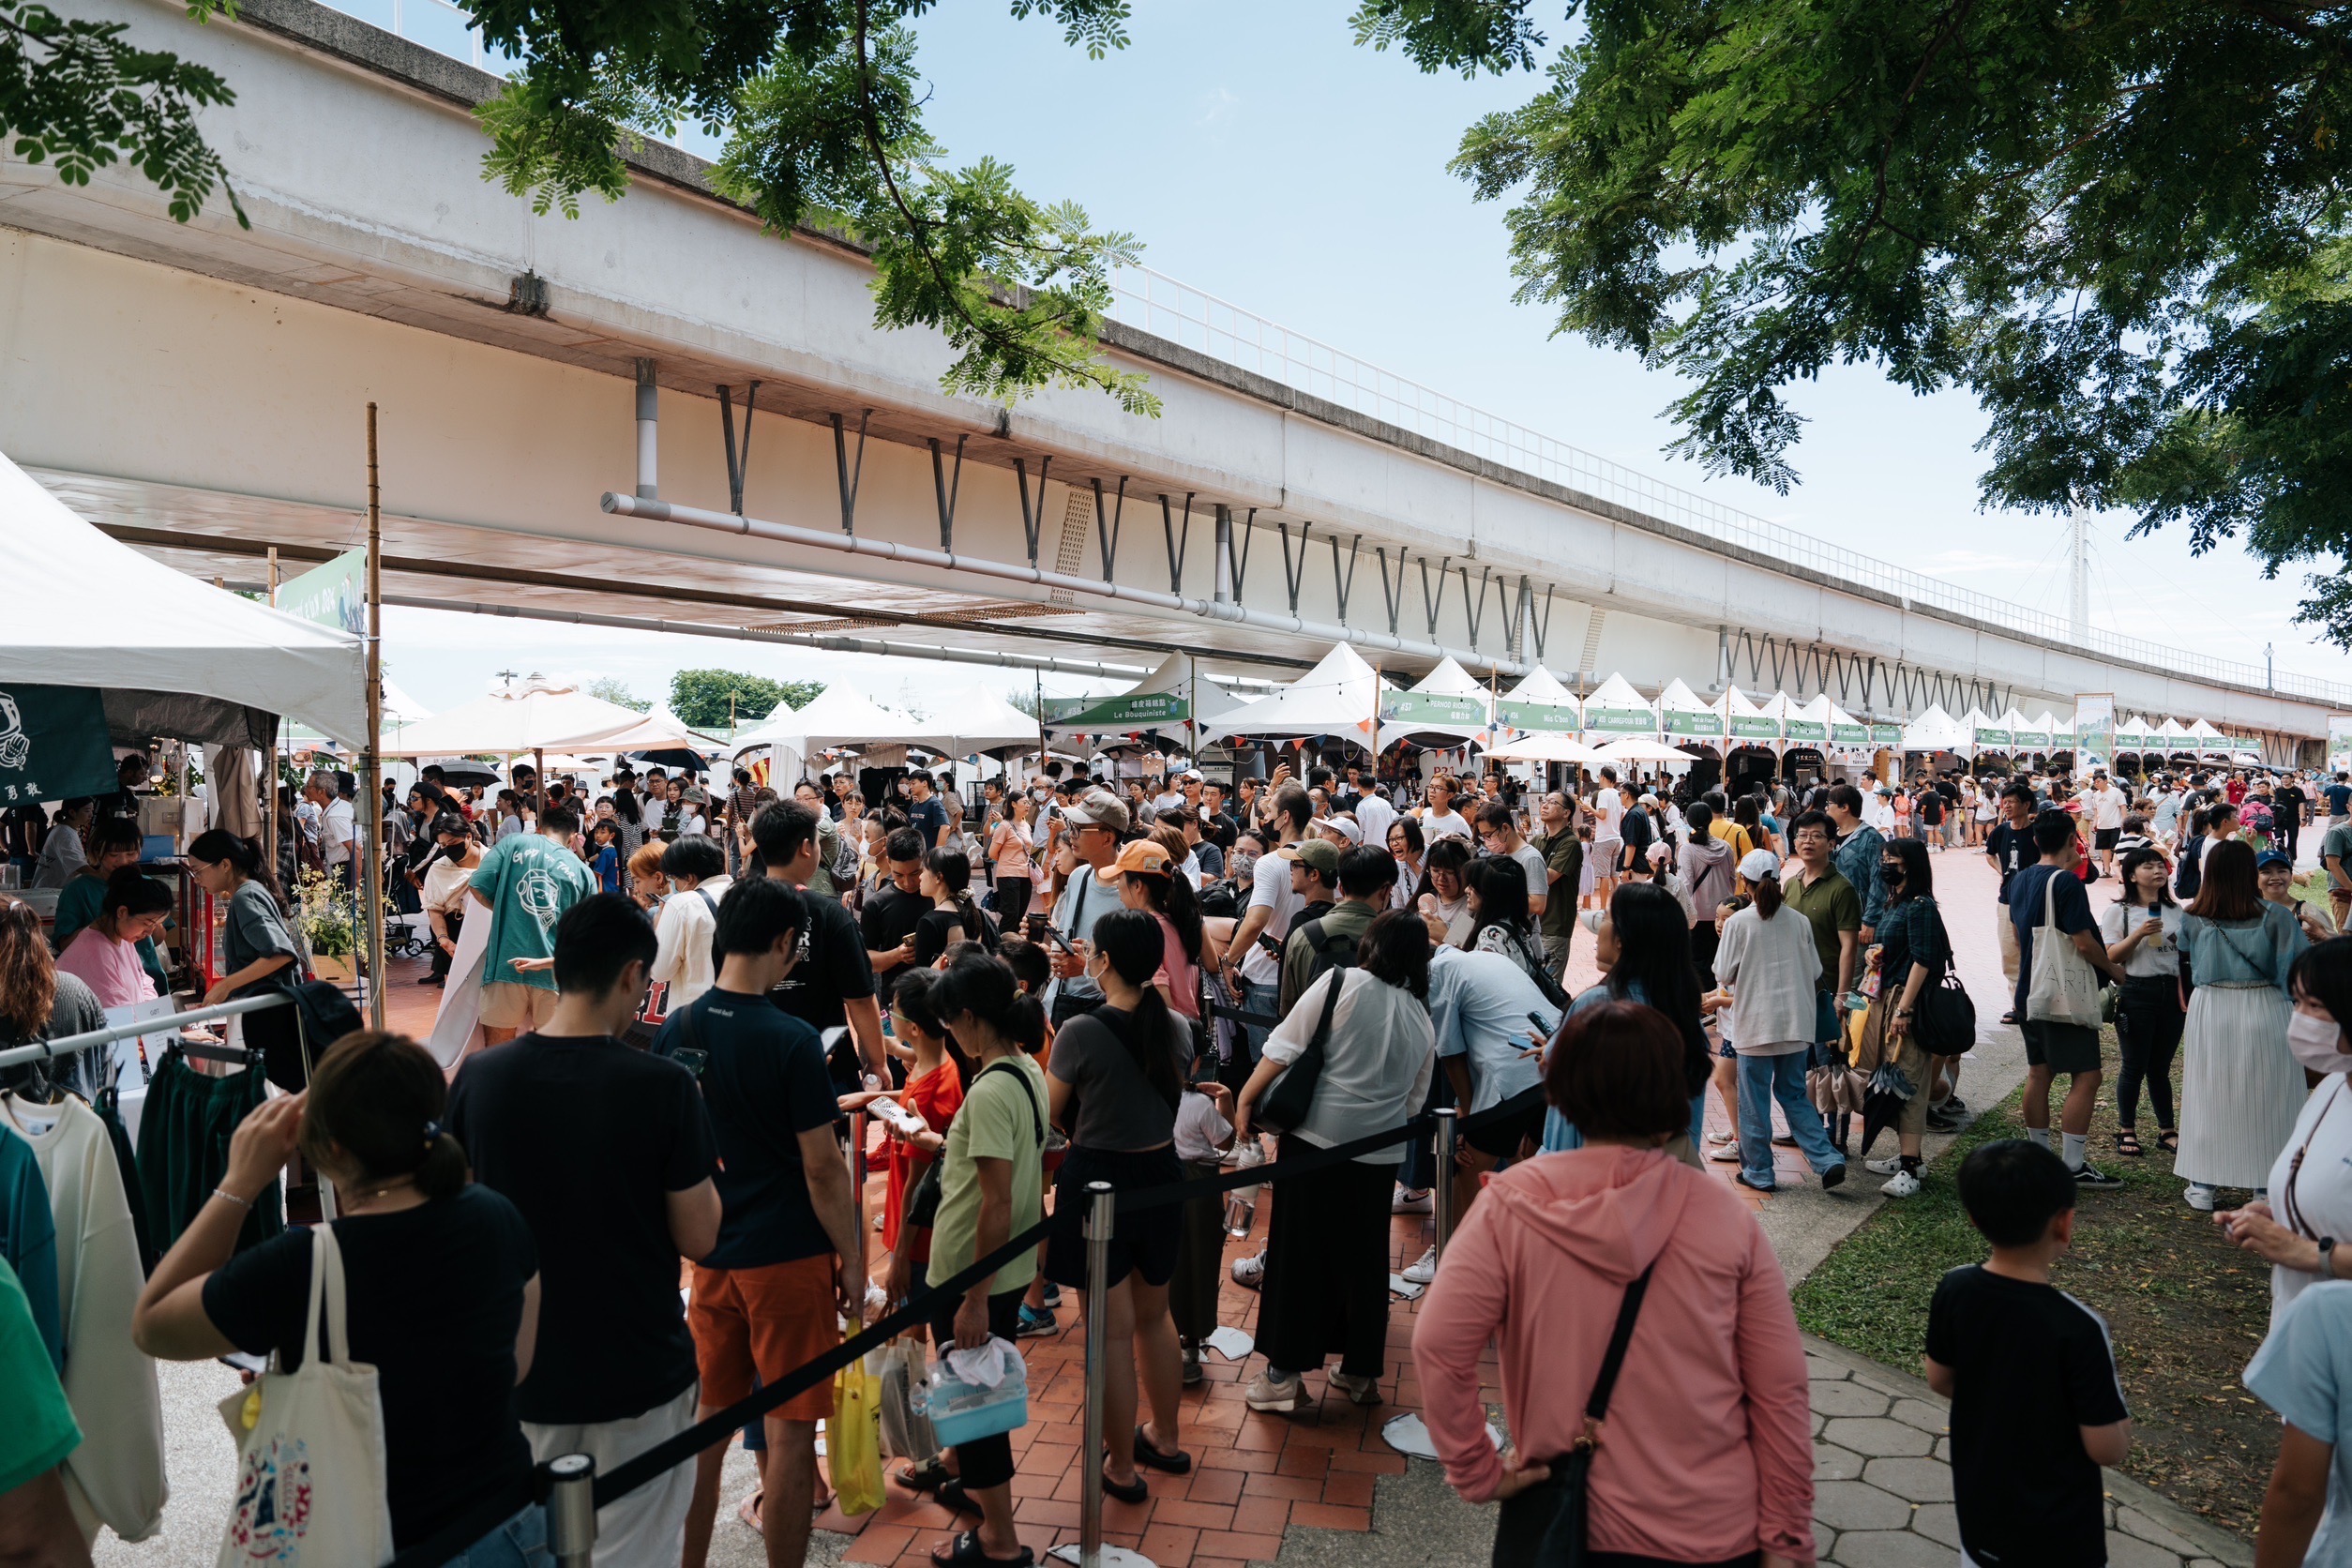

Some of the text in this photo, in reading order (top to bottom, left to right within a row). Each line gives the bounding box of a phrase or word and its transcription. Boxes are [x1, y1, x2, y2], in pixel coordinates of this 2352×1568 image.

[1400, 702, 1412, 711] #37
[1124, 710, 1167, 719] Bouquiniste
[2042, 962, 2088, 993] ART
